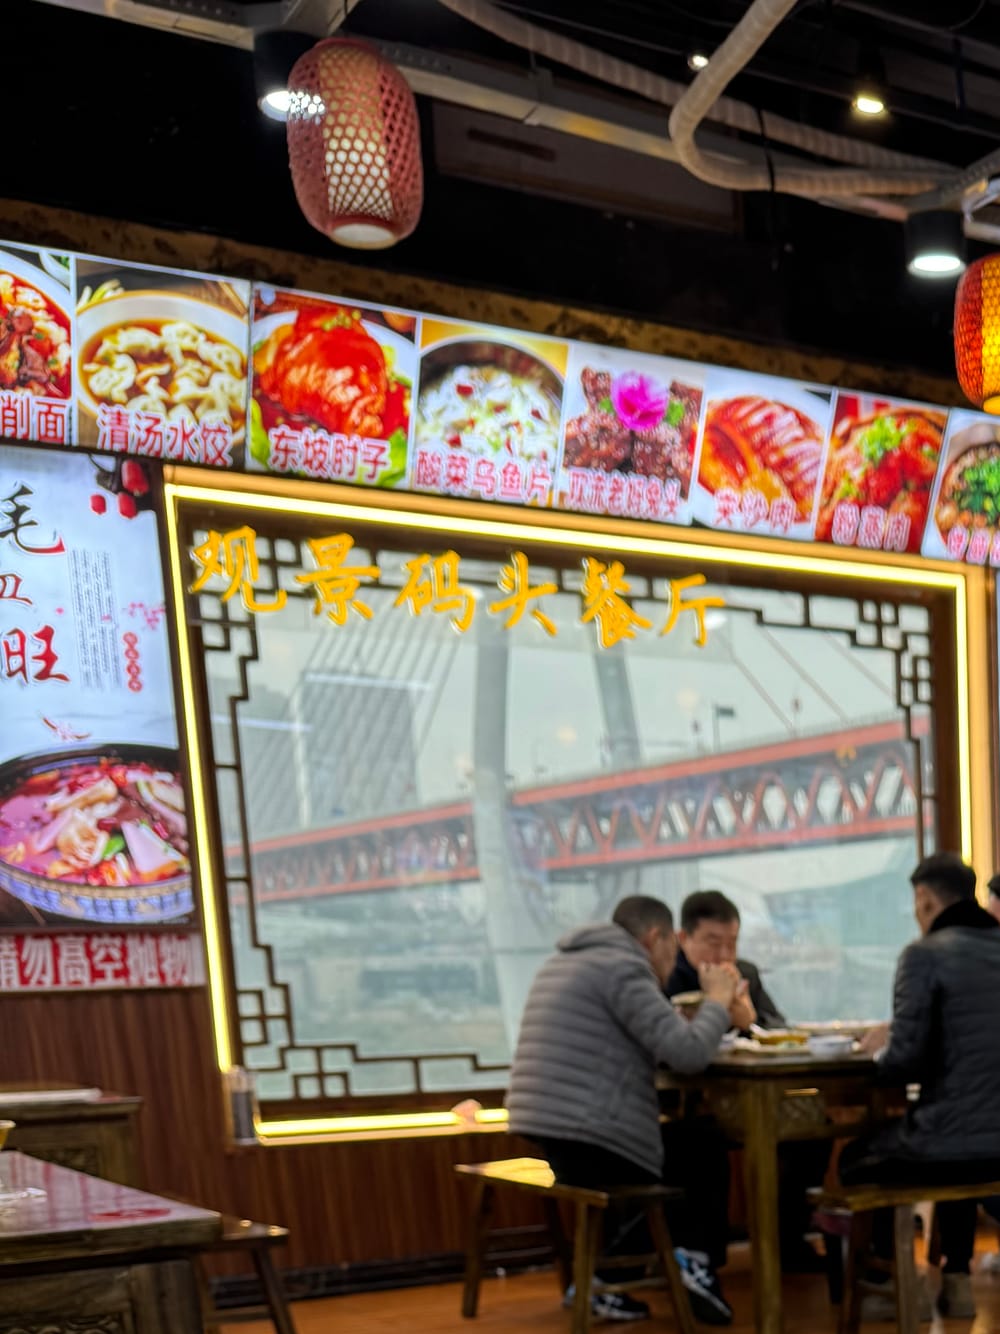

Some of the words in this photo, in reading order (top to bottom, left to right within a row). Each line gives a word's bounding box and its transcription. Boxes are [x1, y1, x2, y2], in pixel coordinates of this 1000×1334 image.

[0, 391, 68, 443] 削面
[98, 402, 231, 467] 清汤水饺
[269, 425, 391, 482] 东坡肘子
[415, 449, 551, 503] 酸菜乌鱼片
[188, 525, 727, 648] 观景码头餐厅
